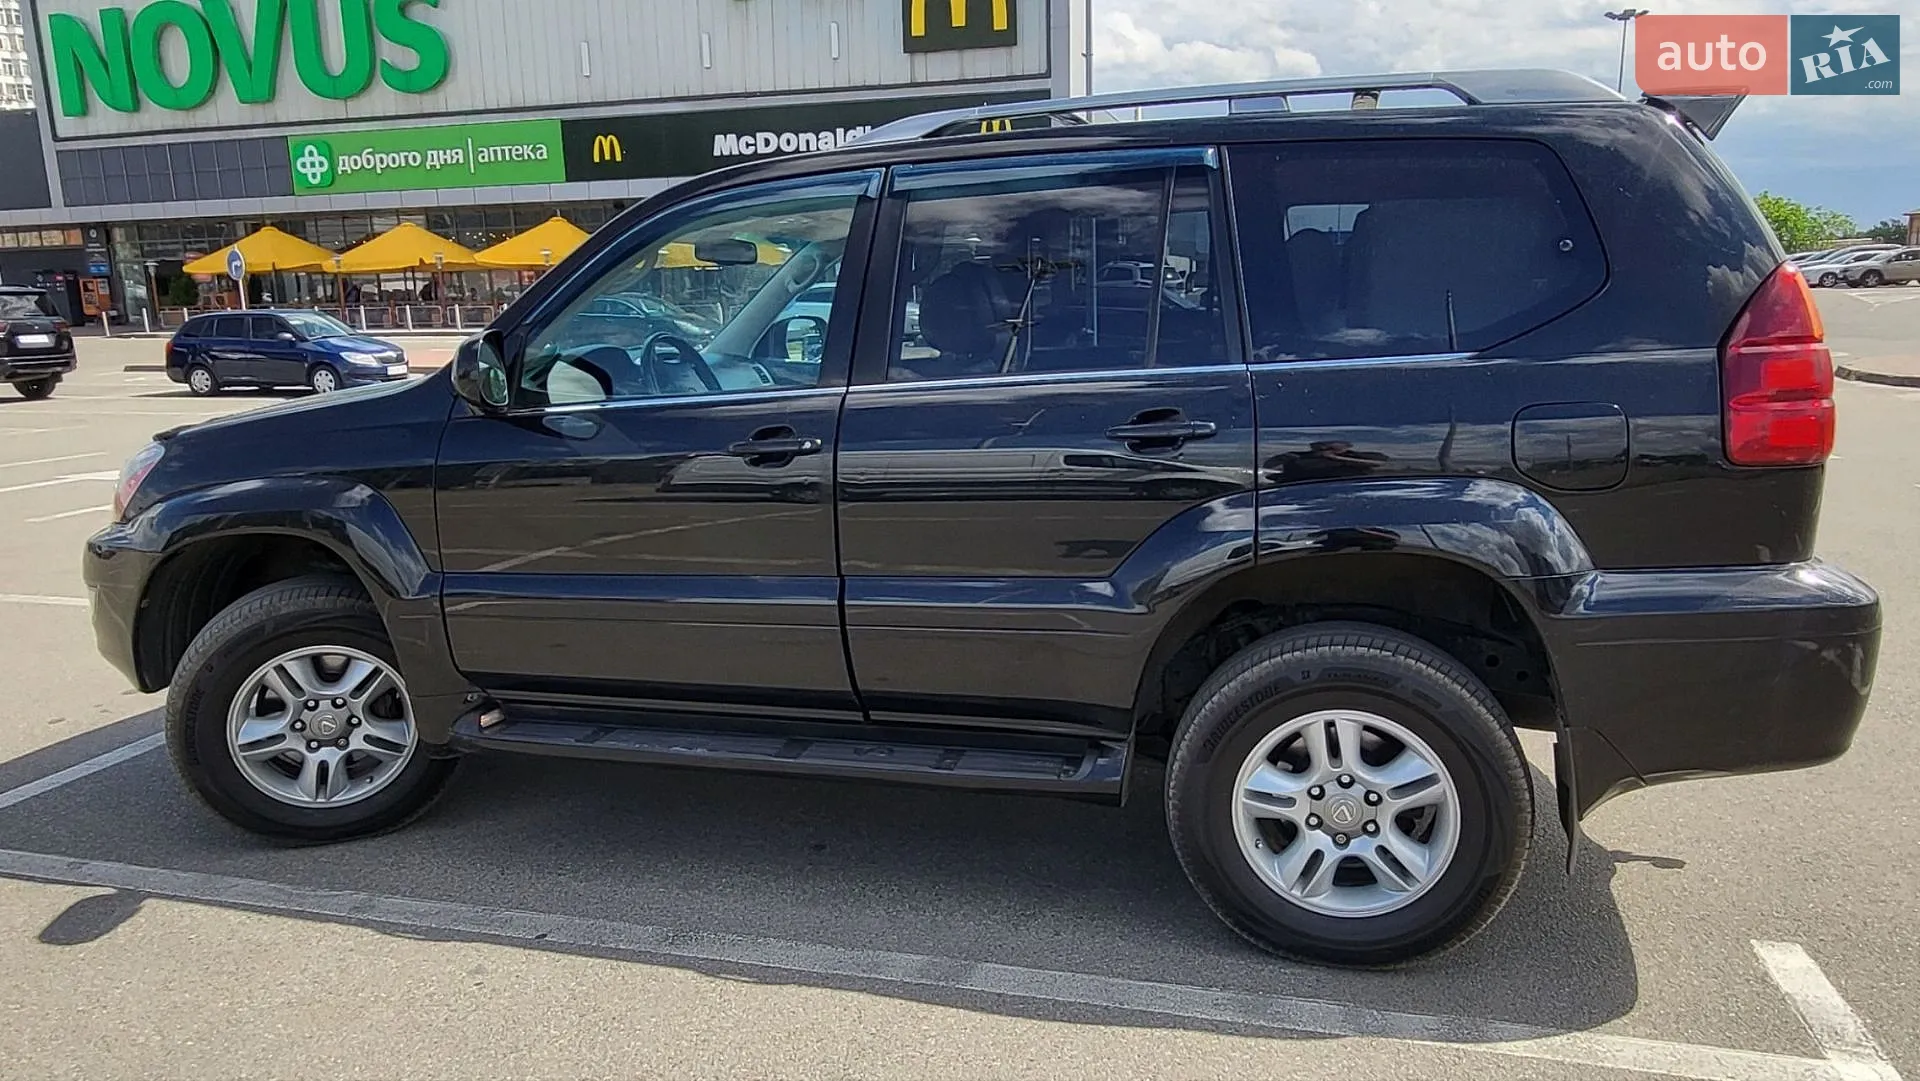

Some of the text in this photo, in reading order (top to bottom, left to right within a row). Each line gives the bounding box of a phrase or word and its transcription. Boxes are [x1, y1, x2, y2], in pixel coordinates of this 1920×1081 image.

[47, 0, 451, 118] NOVUS
[337, 142, 549, 175] доброго дня аптека
